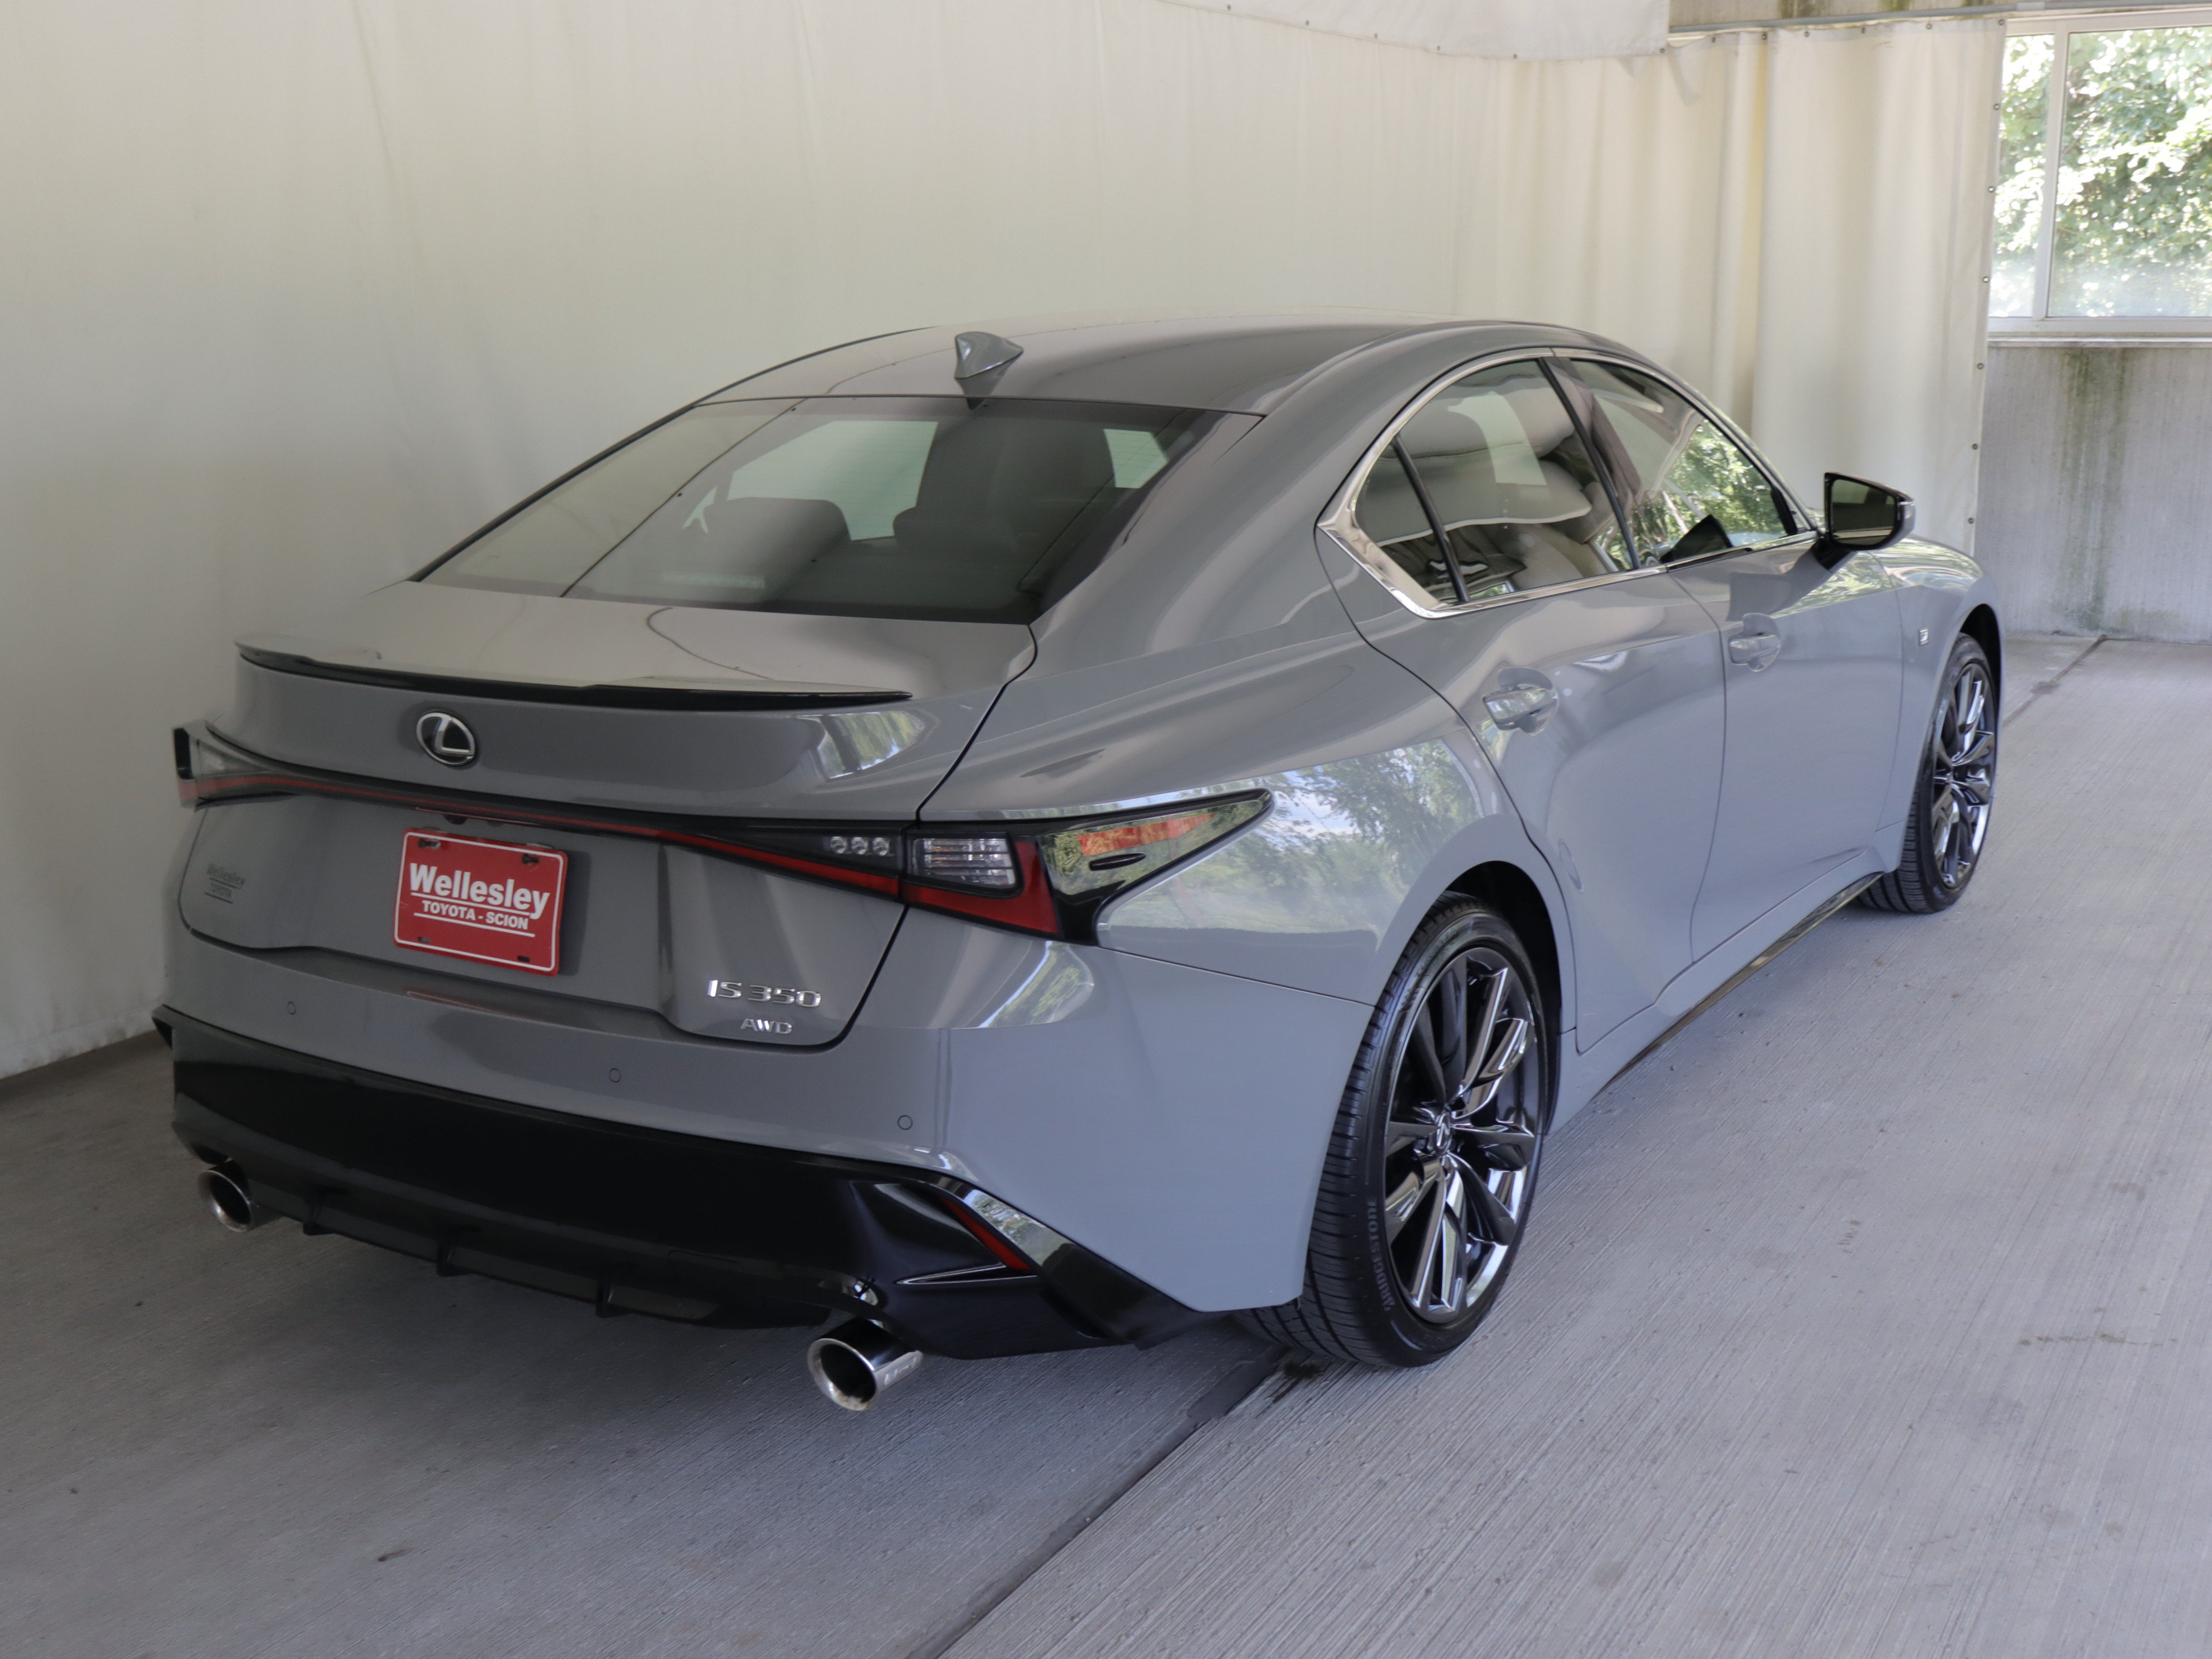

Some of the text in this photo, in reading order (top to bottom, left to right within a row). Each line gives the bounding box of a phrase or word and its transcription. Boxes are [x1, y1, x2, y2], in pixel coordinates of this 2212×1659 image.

[410, 863, 550, 920] Wellesley
[422, 900, 476, 920] TOYOTA
[486, 912, 529, 930] SCION
[707, 980, 821, 1008] IS 350
[740, 1018, 792, 1034] AWD
